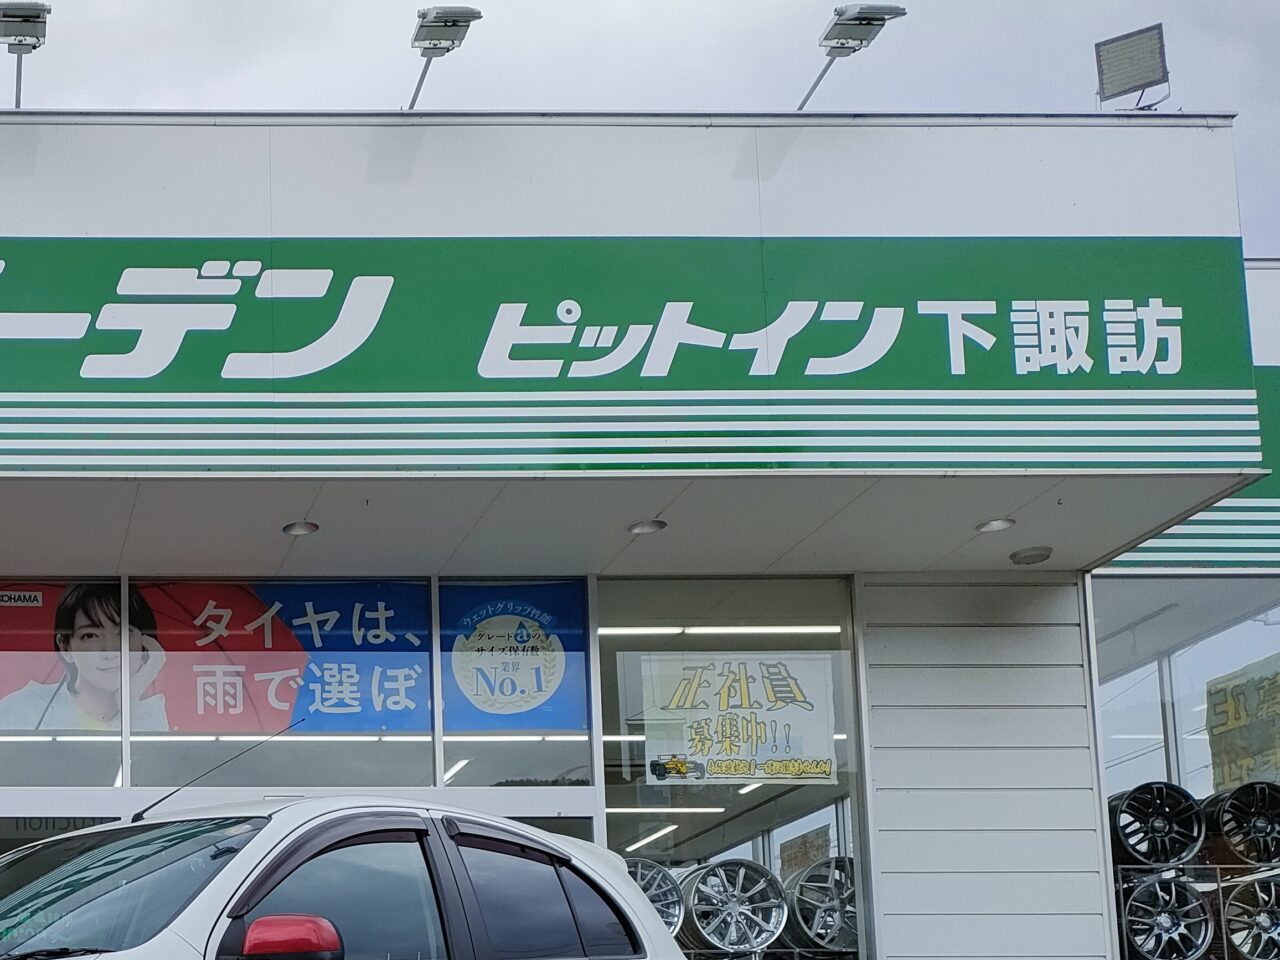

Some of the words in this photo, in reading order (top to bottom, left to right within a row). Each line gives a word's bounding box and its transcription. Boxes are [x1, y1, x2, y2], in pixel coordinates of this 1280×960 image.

[193, 599, 422, 649] タイヤは、
[472, 664, 547, 697] No.1
[500, 661, 520, 673] 業界
[660, 661, 815, 712] 正社員
